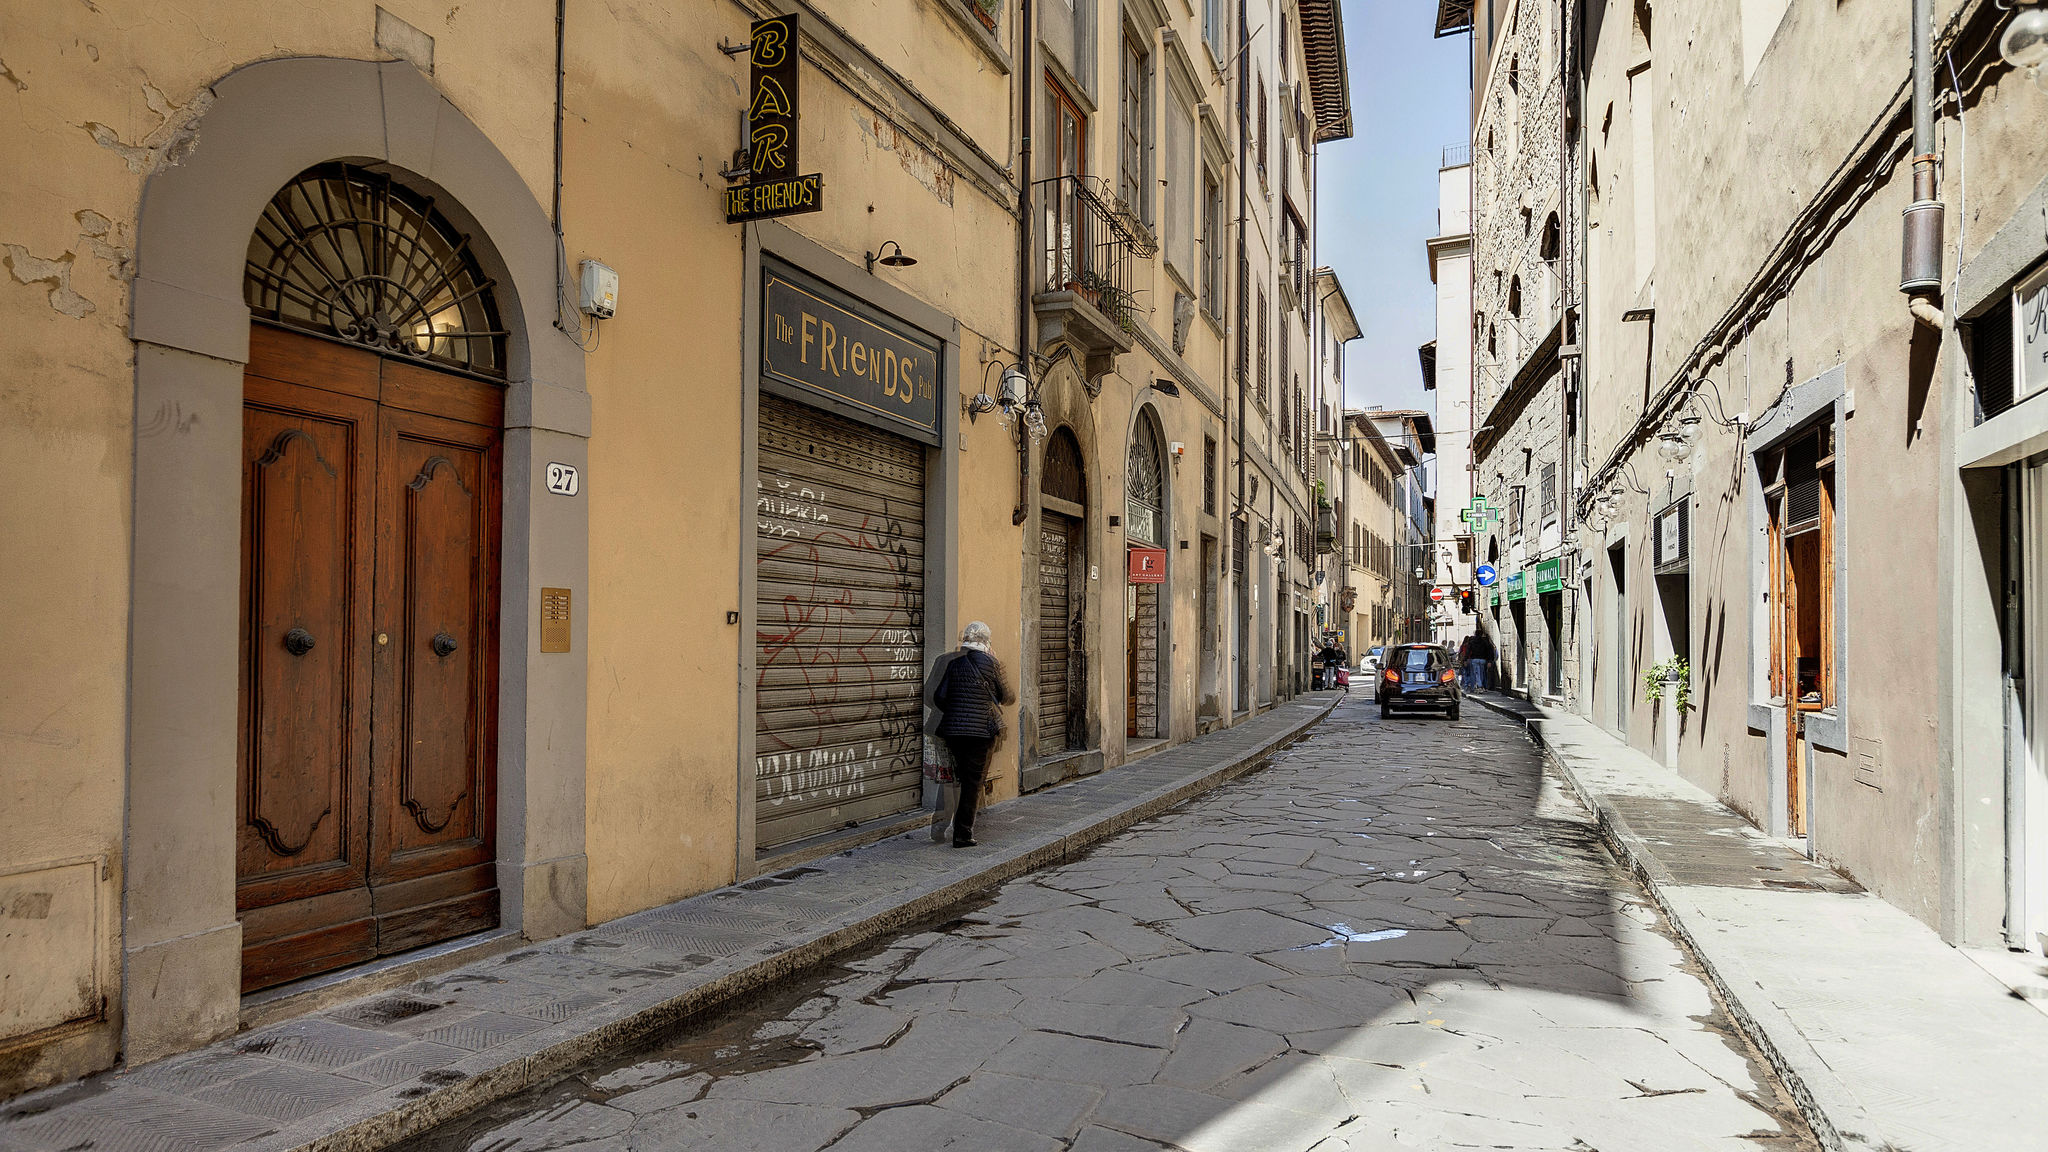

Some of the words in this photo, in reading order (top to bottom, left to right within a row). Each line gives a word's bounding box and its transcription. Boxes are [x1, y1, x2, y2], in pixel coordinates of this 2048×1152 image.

[747, 19, 791, 174] BAR
[726, 187, 751, 216] THE
[774, 313, 794, 345] The
[918, 375, 932, 400] Pub
[551, 467, 575, 492] 27
[1141, 555, 1155, 572] fg
[1536, 566, 1558, 583] FARMACIA
